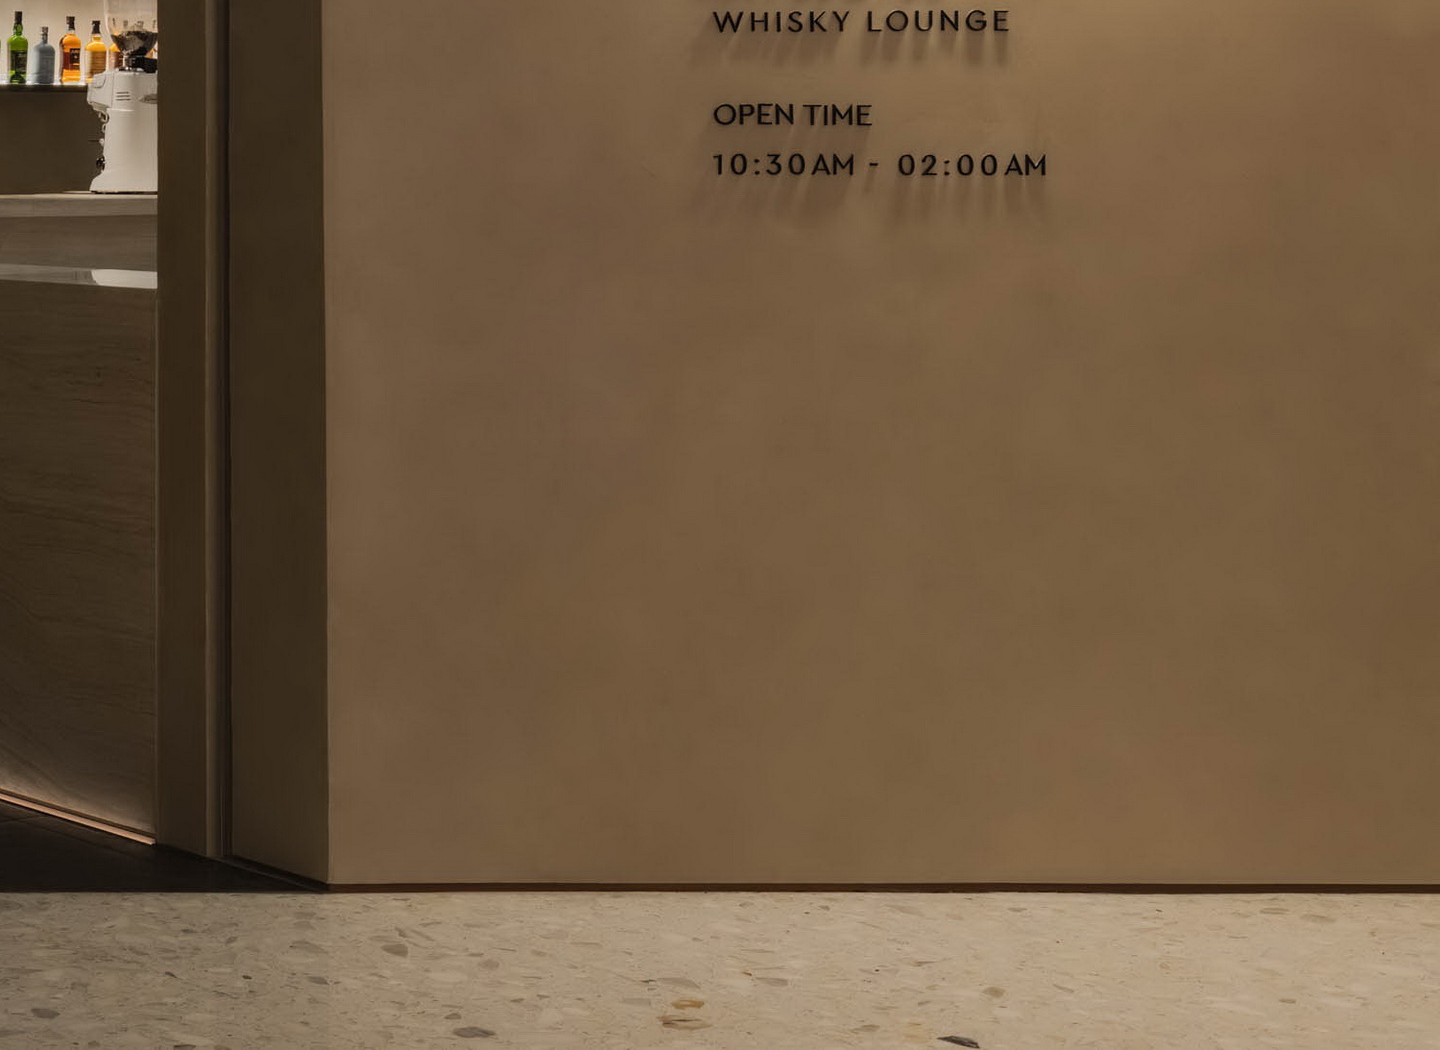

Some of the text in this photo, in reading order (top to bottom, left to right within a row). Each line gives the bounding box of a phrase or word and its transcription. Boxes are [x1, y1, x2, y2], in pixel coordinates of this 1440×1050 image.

[712, 10, 1010, 34] WHISKY LOUNGE
[713, 103, 873, 127] OPEN TIME
[712, 153, 855, 177] 10:30AM
[897, 153, 1047, 177] 02:00AM
